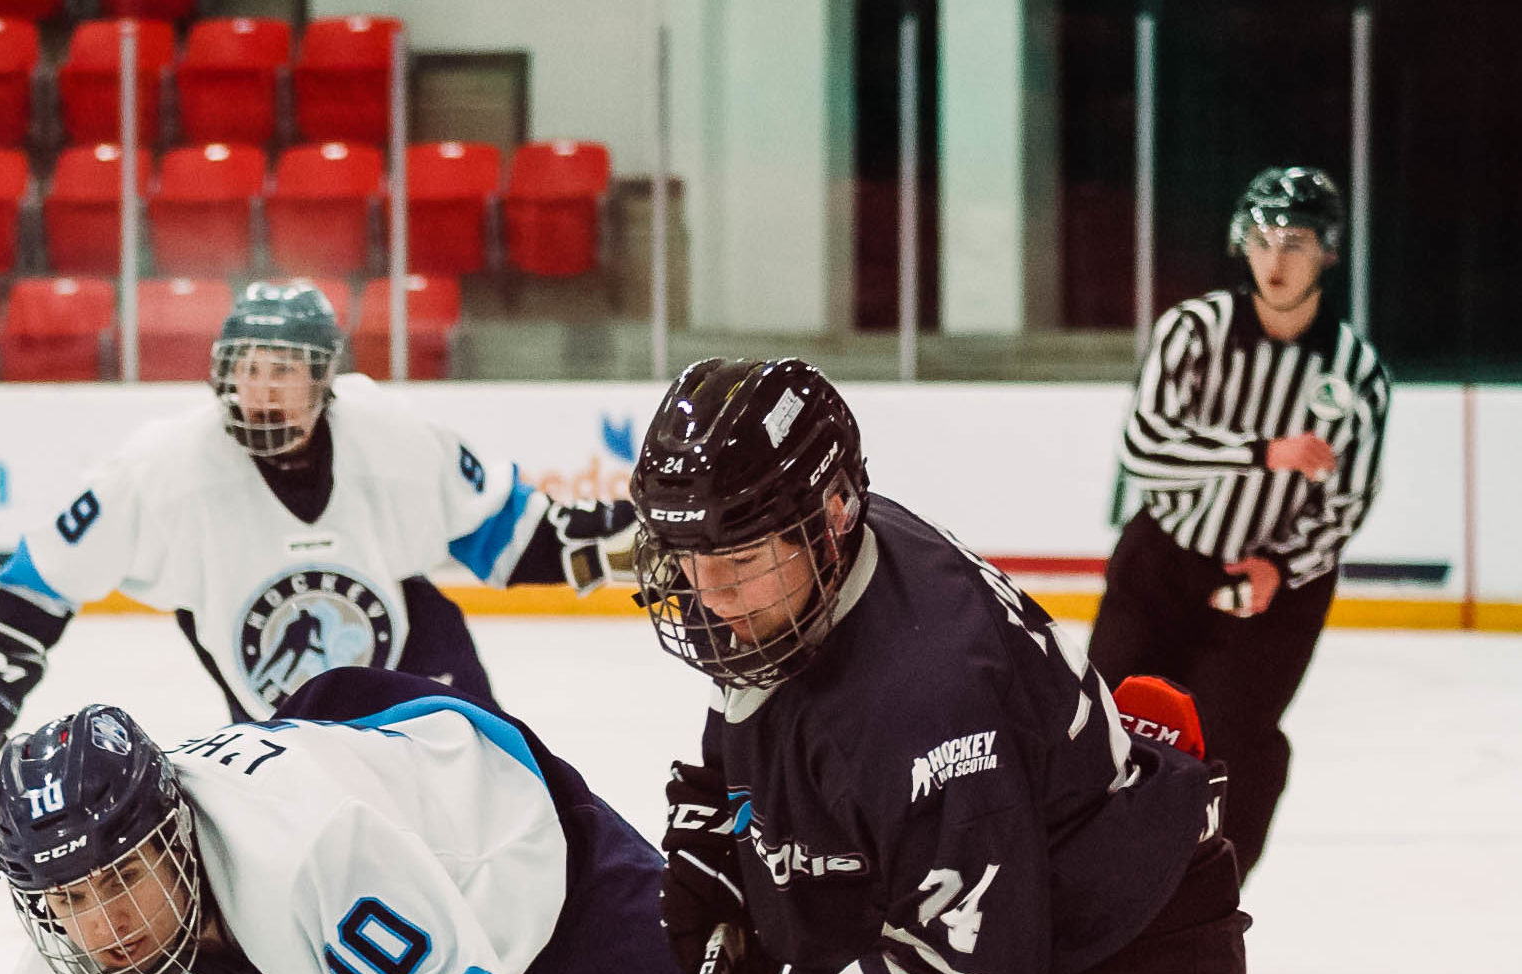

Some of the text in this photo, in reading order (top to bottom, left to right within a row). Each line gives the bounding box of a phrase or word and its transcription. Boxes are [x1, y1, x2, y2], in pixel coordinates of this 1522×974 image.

[663, 457, 684, 474] 24
[56, 489, 100, 544] 9
[650, 508, 706, 522] CCM
[246, 572, 385, 630] HOCKEY
[927, 730, 997, 774] HOCKEY
[954, 754, 998, 778] SCOTIA
[27, 777, 66, 820] 10
[33, 834, 88, 864] CCM
[917, 863, 1001, 954] 24
